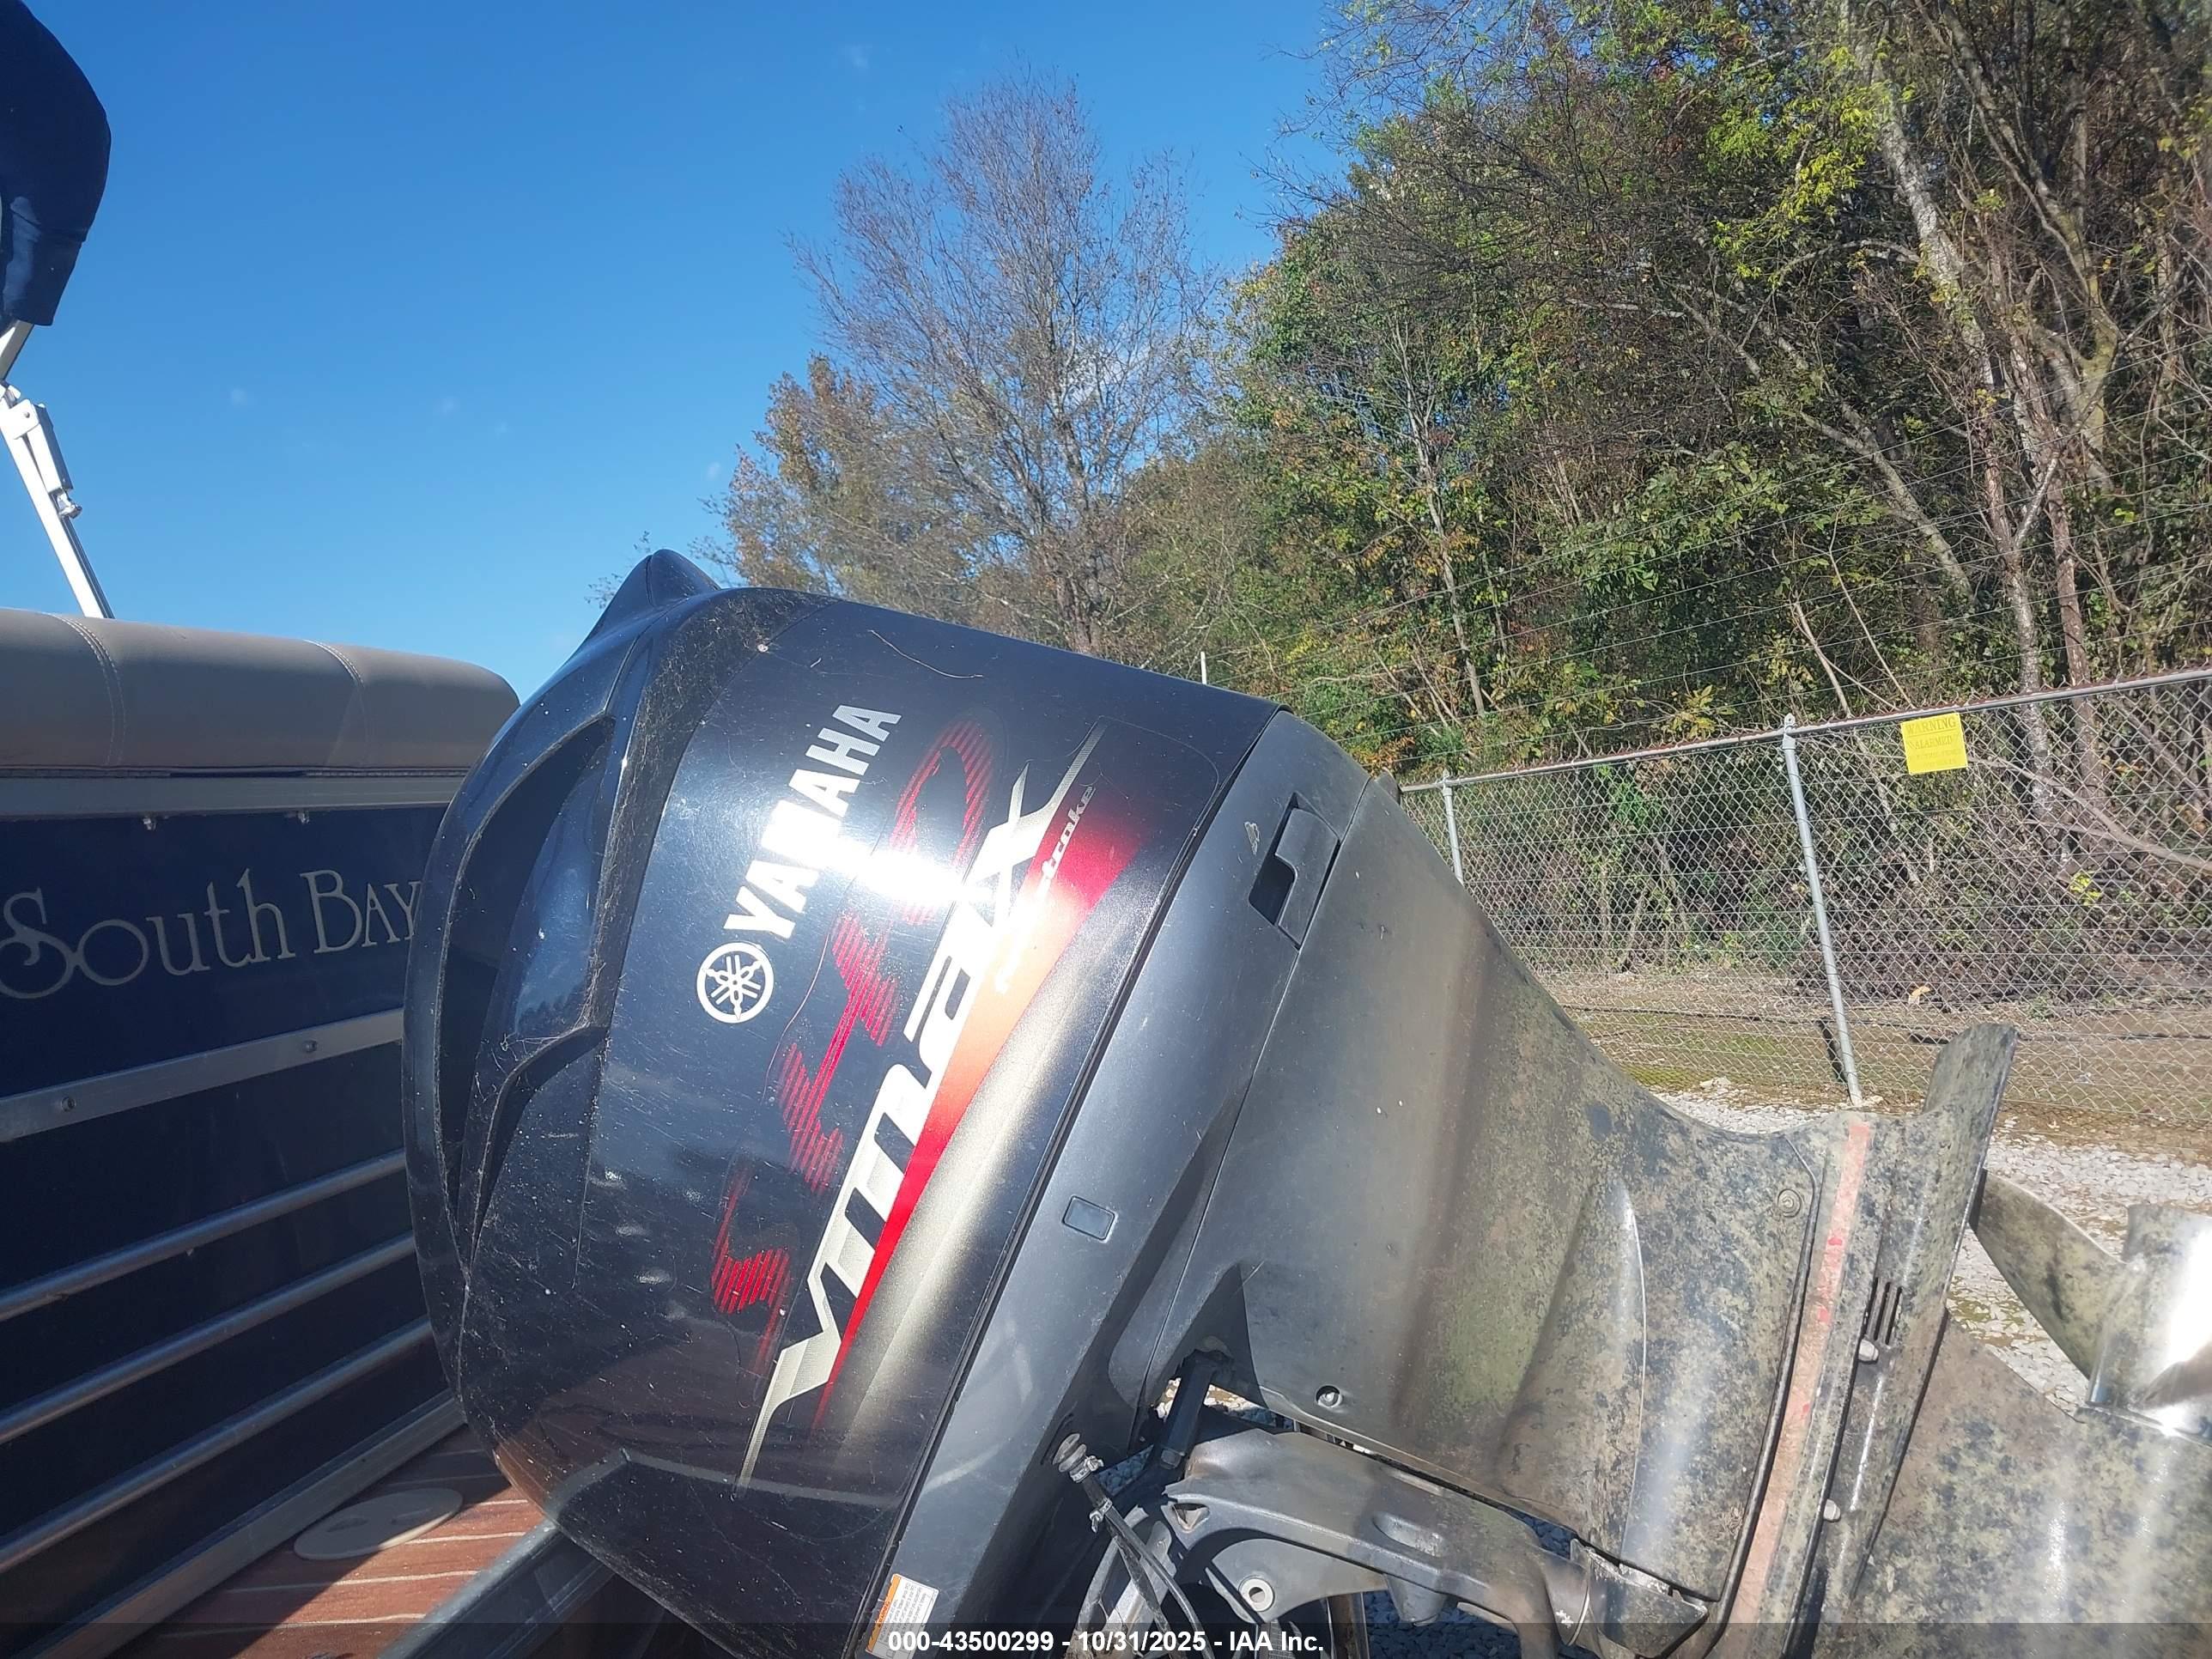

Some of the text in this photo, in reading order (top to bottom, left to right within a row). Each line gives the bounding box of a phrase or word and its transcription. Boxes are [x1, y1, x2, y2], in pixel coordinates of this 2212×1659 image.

[1906, 717, 1956, 734] WARNING
[723, 704, 902, 939] YAMAHA
[300, 869, 421, 954] BAY
